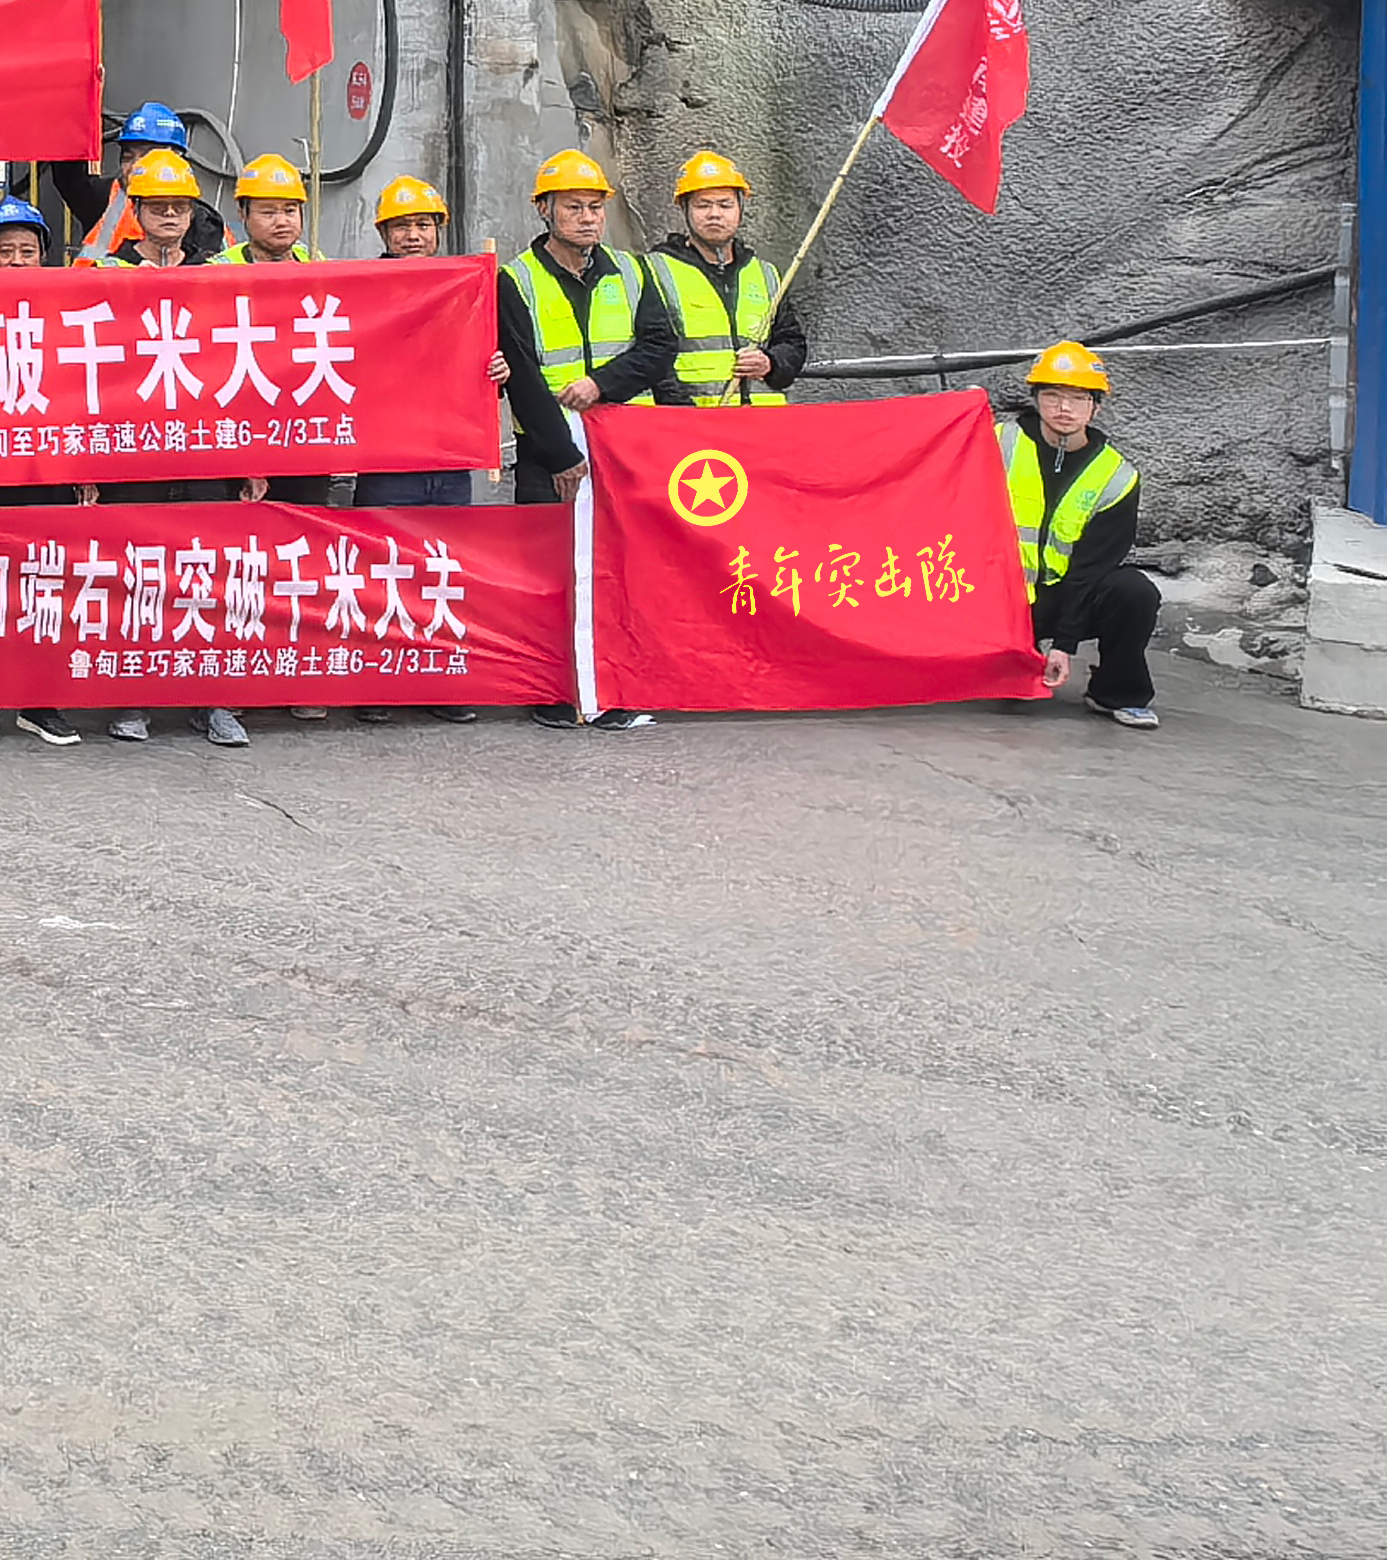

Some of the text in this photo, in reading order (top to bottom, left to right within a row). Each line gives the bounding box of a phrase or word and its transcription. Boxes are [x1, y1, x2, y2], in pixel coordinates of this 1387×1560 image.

[67, 644, 470, 680] 鲁甸至巧家高速公路土建6-2/3工点
